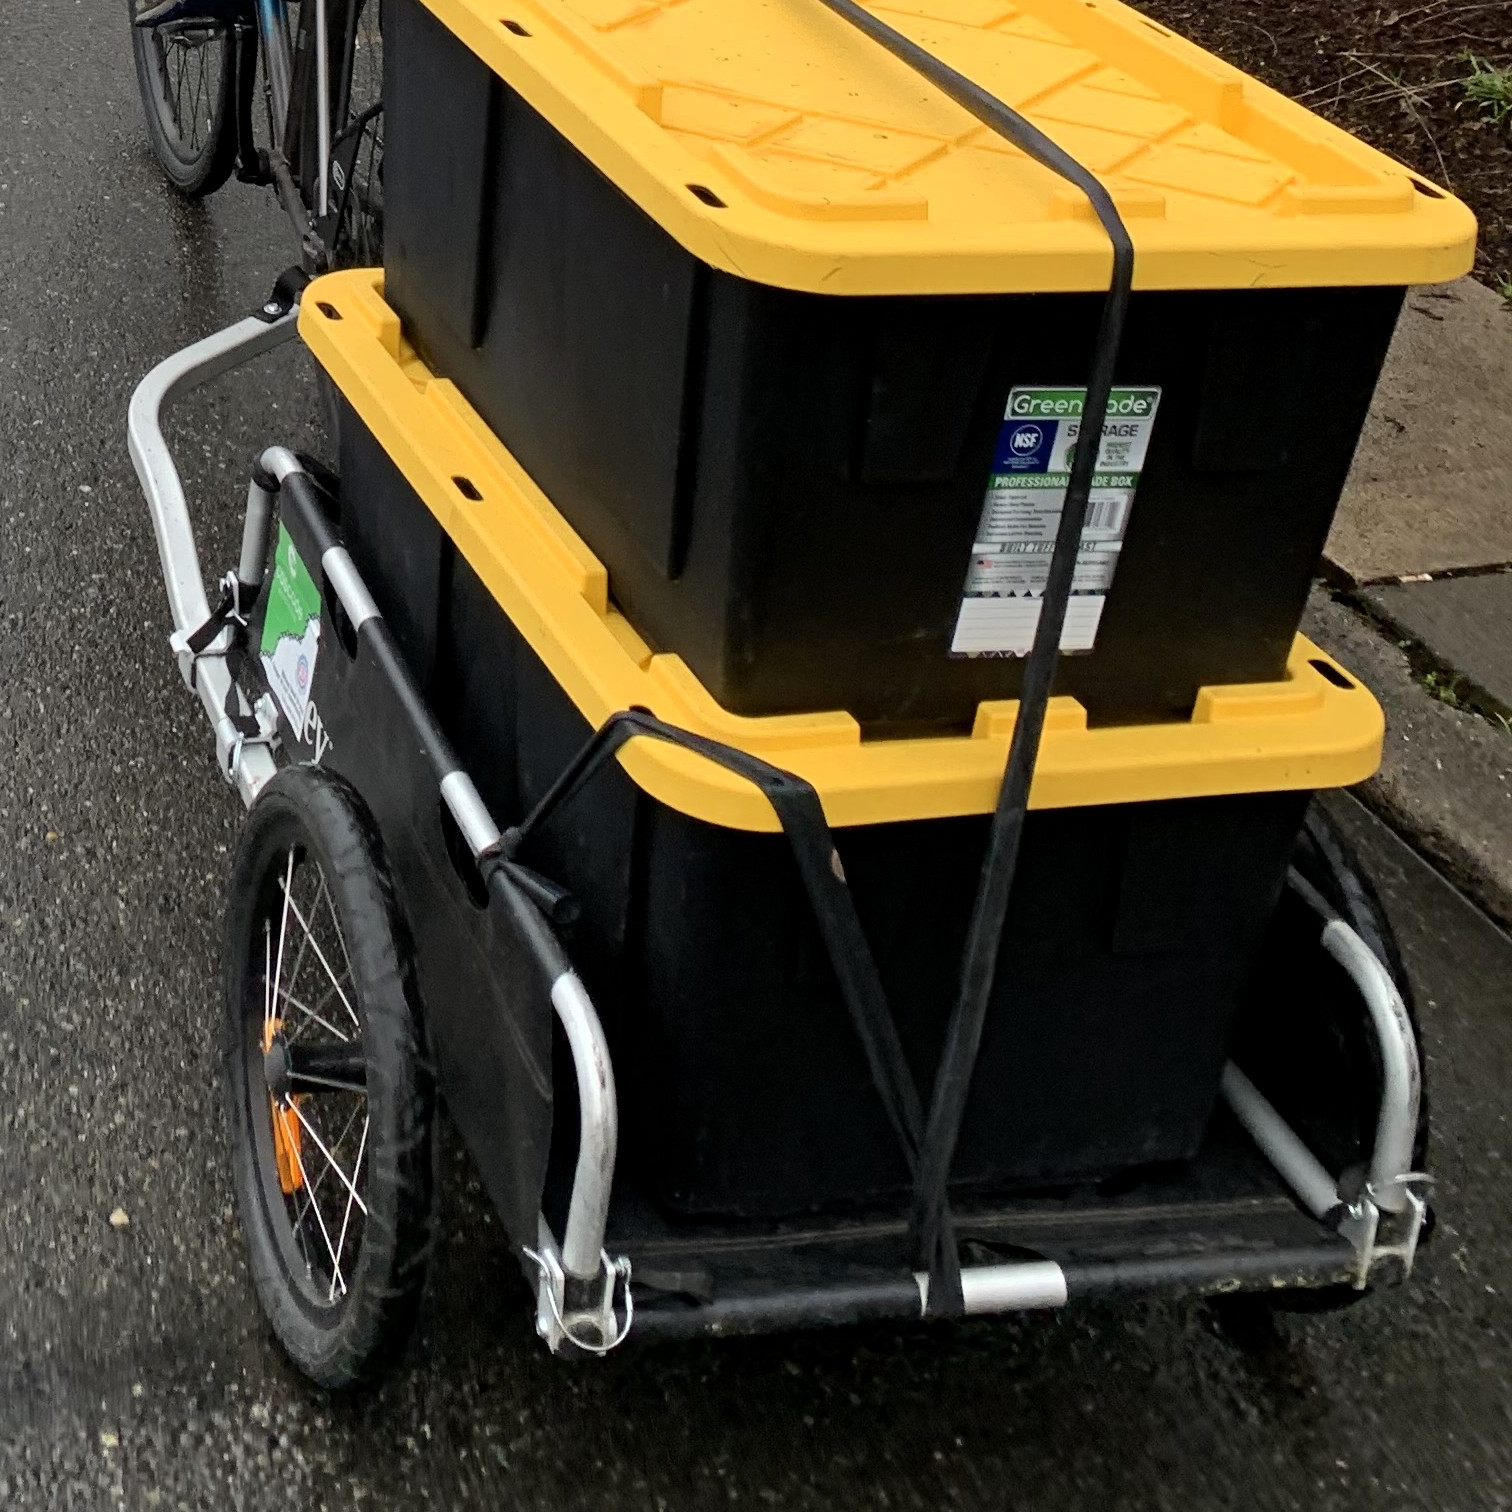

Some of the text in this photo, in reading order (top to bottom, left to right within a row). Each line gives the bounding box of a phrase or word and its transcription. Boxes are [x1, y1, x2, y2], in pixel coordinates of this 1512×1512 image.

[1013, 394, 1148, 414] Greenade
[1067, 424, 1139, 438] SRAGE
[1013, 433, 1039, 449] NSF
[994, 476, 1069, 487] PROFESSIONA
[1111, 476, 1134, 487] BOX
